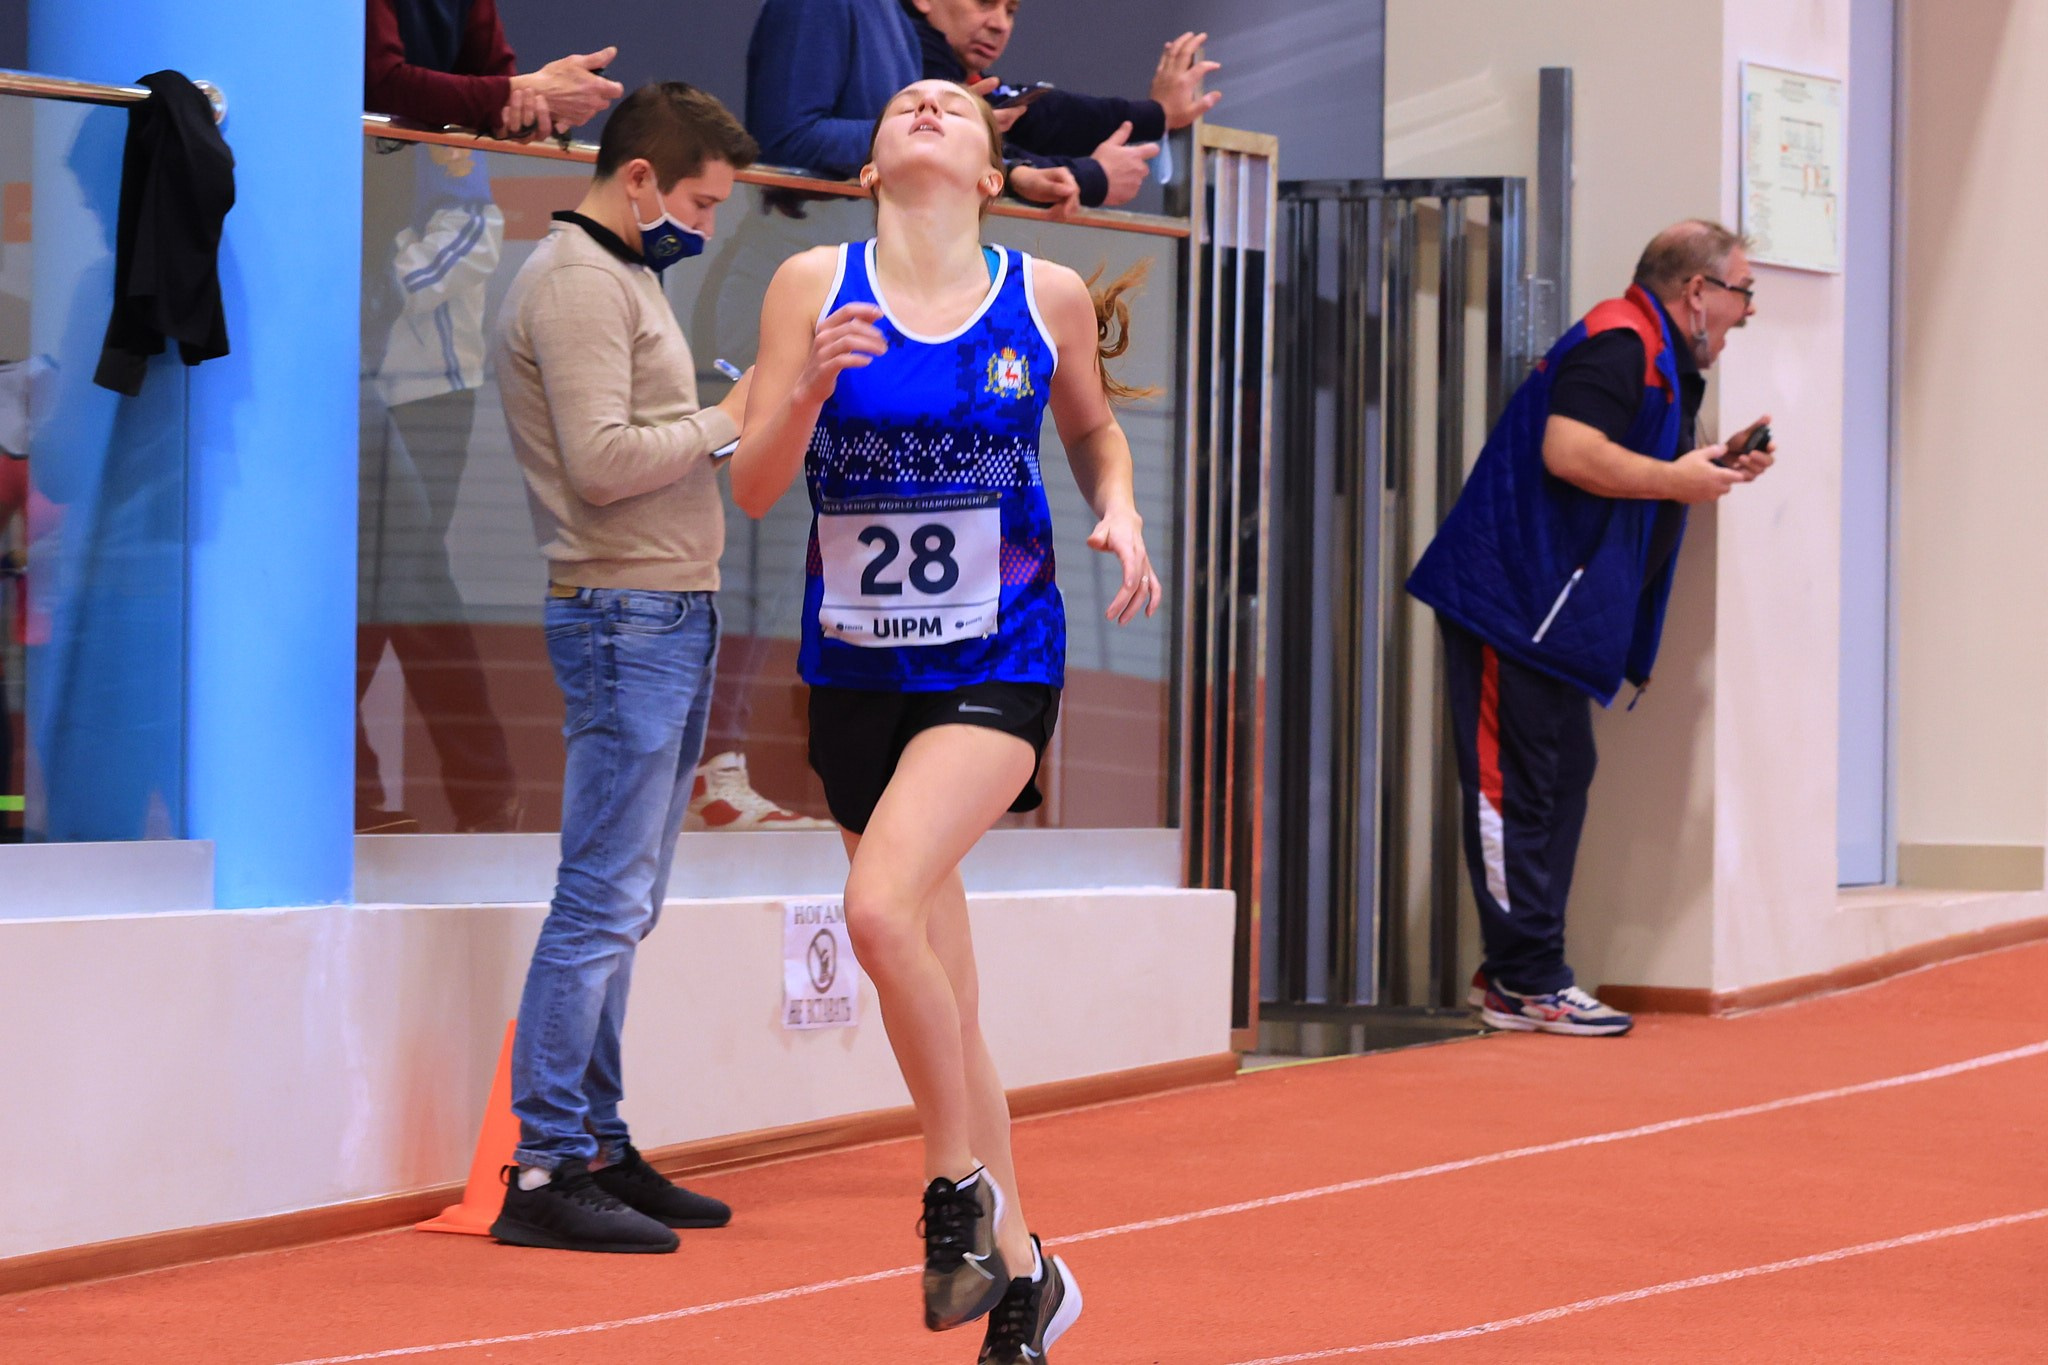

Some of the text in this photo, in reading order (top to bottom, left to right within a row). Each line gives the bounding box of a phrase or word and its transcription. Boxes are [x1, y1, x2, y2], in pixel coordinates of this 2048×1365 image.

[843, 502, 876, 511] SENIOR
[878, 500, 912, 510] WORLD
[914, 495, 989, 509] CHAMPIONSHIP
[857, 523, 959, 596] 28
[873, 616, 943, 639] UIPM
[794, 905, 845, 925] НОГАМ
